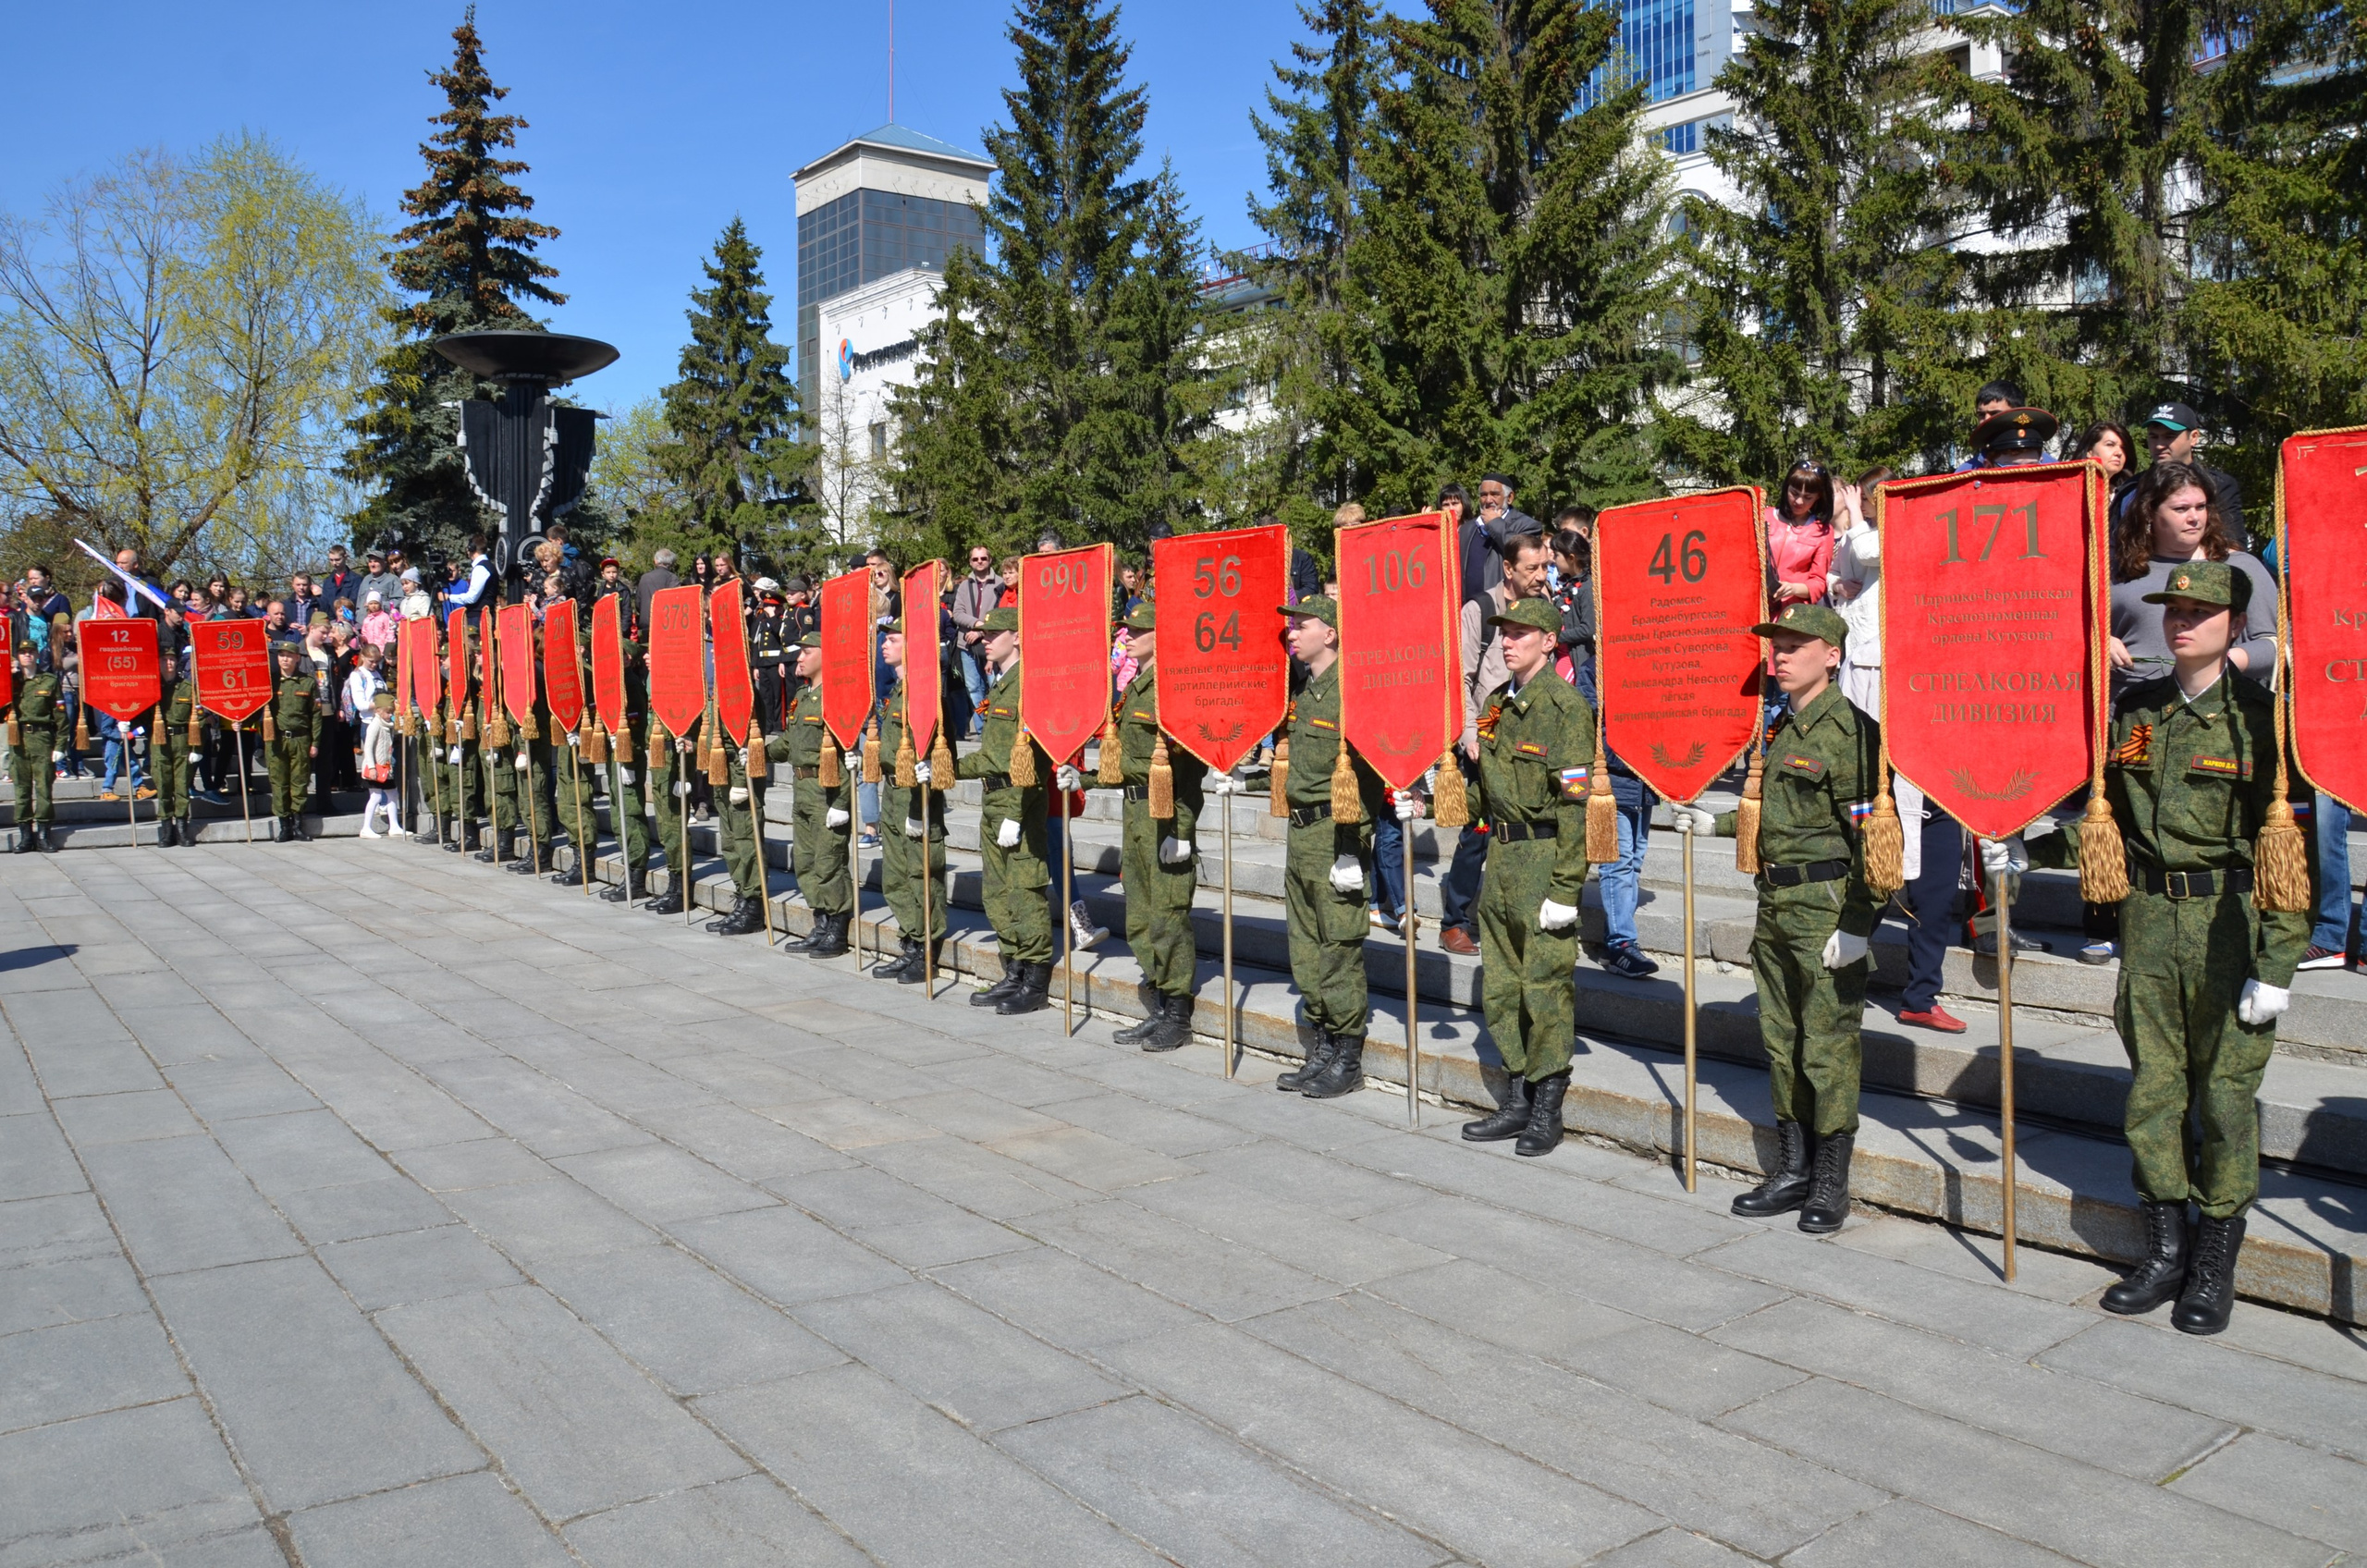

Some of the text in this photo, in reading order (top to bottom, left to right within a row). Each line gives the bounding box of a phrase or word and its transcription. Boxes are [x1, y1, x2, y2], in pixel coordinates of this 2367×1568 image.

[1934, 500, 2049, 566] 171
[1648, 530, 1708, 585] 46
[1040, 560, 1087, 600] 990
[1194, 555, 1243, 598] 56
[1363, 544, 1427, 596] 106
[836, 593, 852, 614] 119
[1650, 596, 1707, 609] Радомско-
[1914, 589, 2073, 609] Идрицко-Берлинская
[662, 603, 690, 631] 378
[1632, 610, 1727, 628] Бранденбургская
[1928, 609, 2058, 627] Краснознаменная
[111, 631, 129, 643] 12
[553, 615, 565, 641] 20
[836, 624, 852, 644] 121
[1195, 610, 1243, 653] 64
[1608, 632, 1650, 644] дважды
[1932, 629, 2054, 646] ордена Кутузова
[217, 631, 244, 650] 59
[1626, 646, 1671, 658] орденов
[107, 655, 137, 672] (55)
[1165, 664, 1279, 676] тяжёлые пушечные
[223, 668, 248, 689] 61
[1362, 668, 1435, 690] ДИВИЗИЯ
[1621, 674, 1739, 690] Александра Невского
[1908, 672, 2081, 692] СТРЕЛКОВАЯ
[1195, 696, 1244, 708] бригады
[1660, 692, 1696, 703] лёгкая
[1613, 705, 1747, 722] артиллерийская бригада
[1931, 704, 2056, 724] ДИВИЗИЯ
